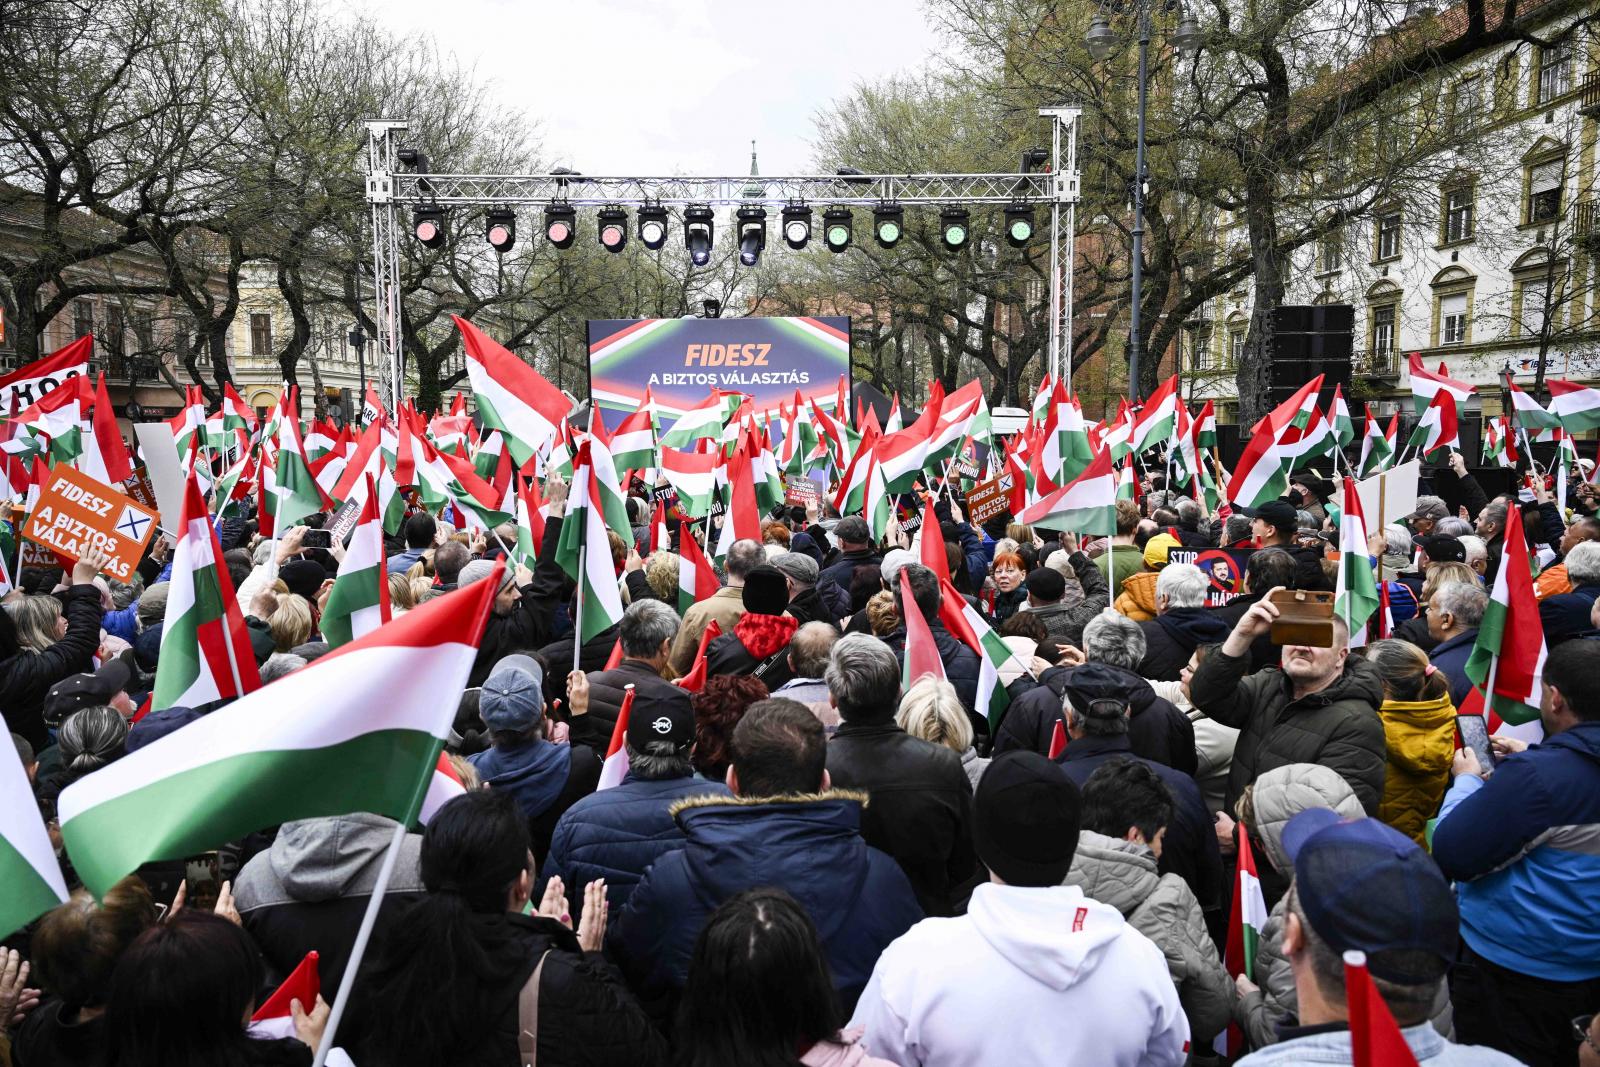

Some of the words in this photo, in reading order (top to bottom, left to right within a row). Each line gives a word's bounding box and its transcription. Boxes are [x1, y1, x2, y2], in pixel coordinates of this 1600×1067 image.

[685, 343, 772, 367] FIDESZ
[649, 374, 660, 385] A
[663, 373, 718, 385] BIZTOS
[720, 369, 809, 385] VÁLASZTÁS
[51, 477, 114, 517] FIDESZ
[655, 487, 676, 501] STOP
[969, 486, 995, 505] FIDESZ
[972, 508, 978, 518] A
[978, 494, 1006, 513] BIZTOS
[37, 506, 53, 523] A
[53, 512, 118, 553] BIZTOS
[1170, 551, 1198, 565] STOP
